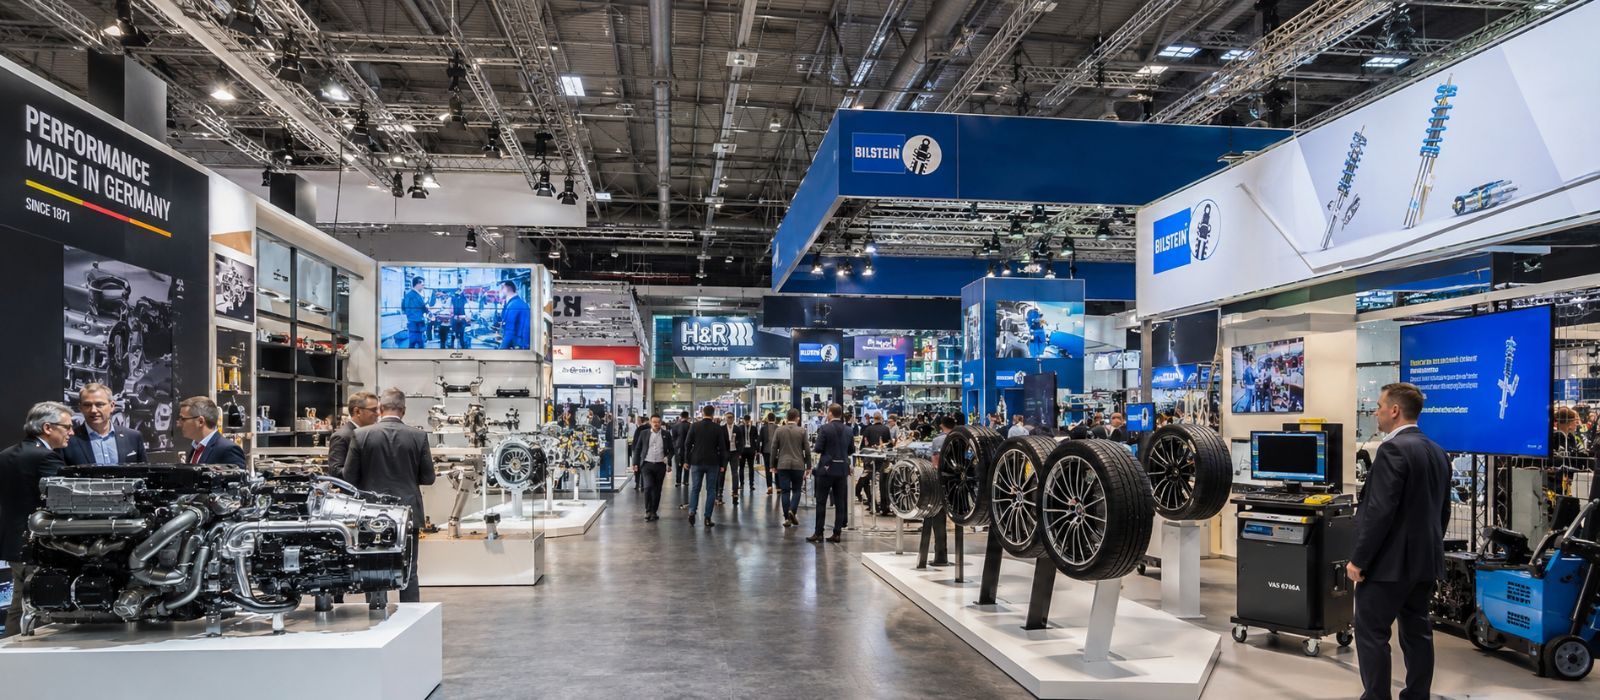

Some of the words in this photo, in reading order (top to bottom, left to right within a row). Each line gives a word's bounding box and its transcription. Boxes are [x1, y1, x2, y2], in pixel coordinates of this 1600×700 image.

[26, 104, 150, 186] PERFORMANCE
[855, 146, 900, 159] BILSTEIN
[26, 139, 78, 185] MADE
[83, 164, 100, 194] IN
[104, 174, 171, 222] GERMANY
[26, 197, 51, 217] SINCE
[52, 206, 71, 223] 1871
[1155, 228, 1188, 254] BILSTEIN
[681, 322, 730, 346] H&R
